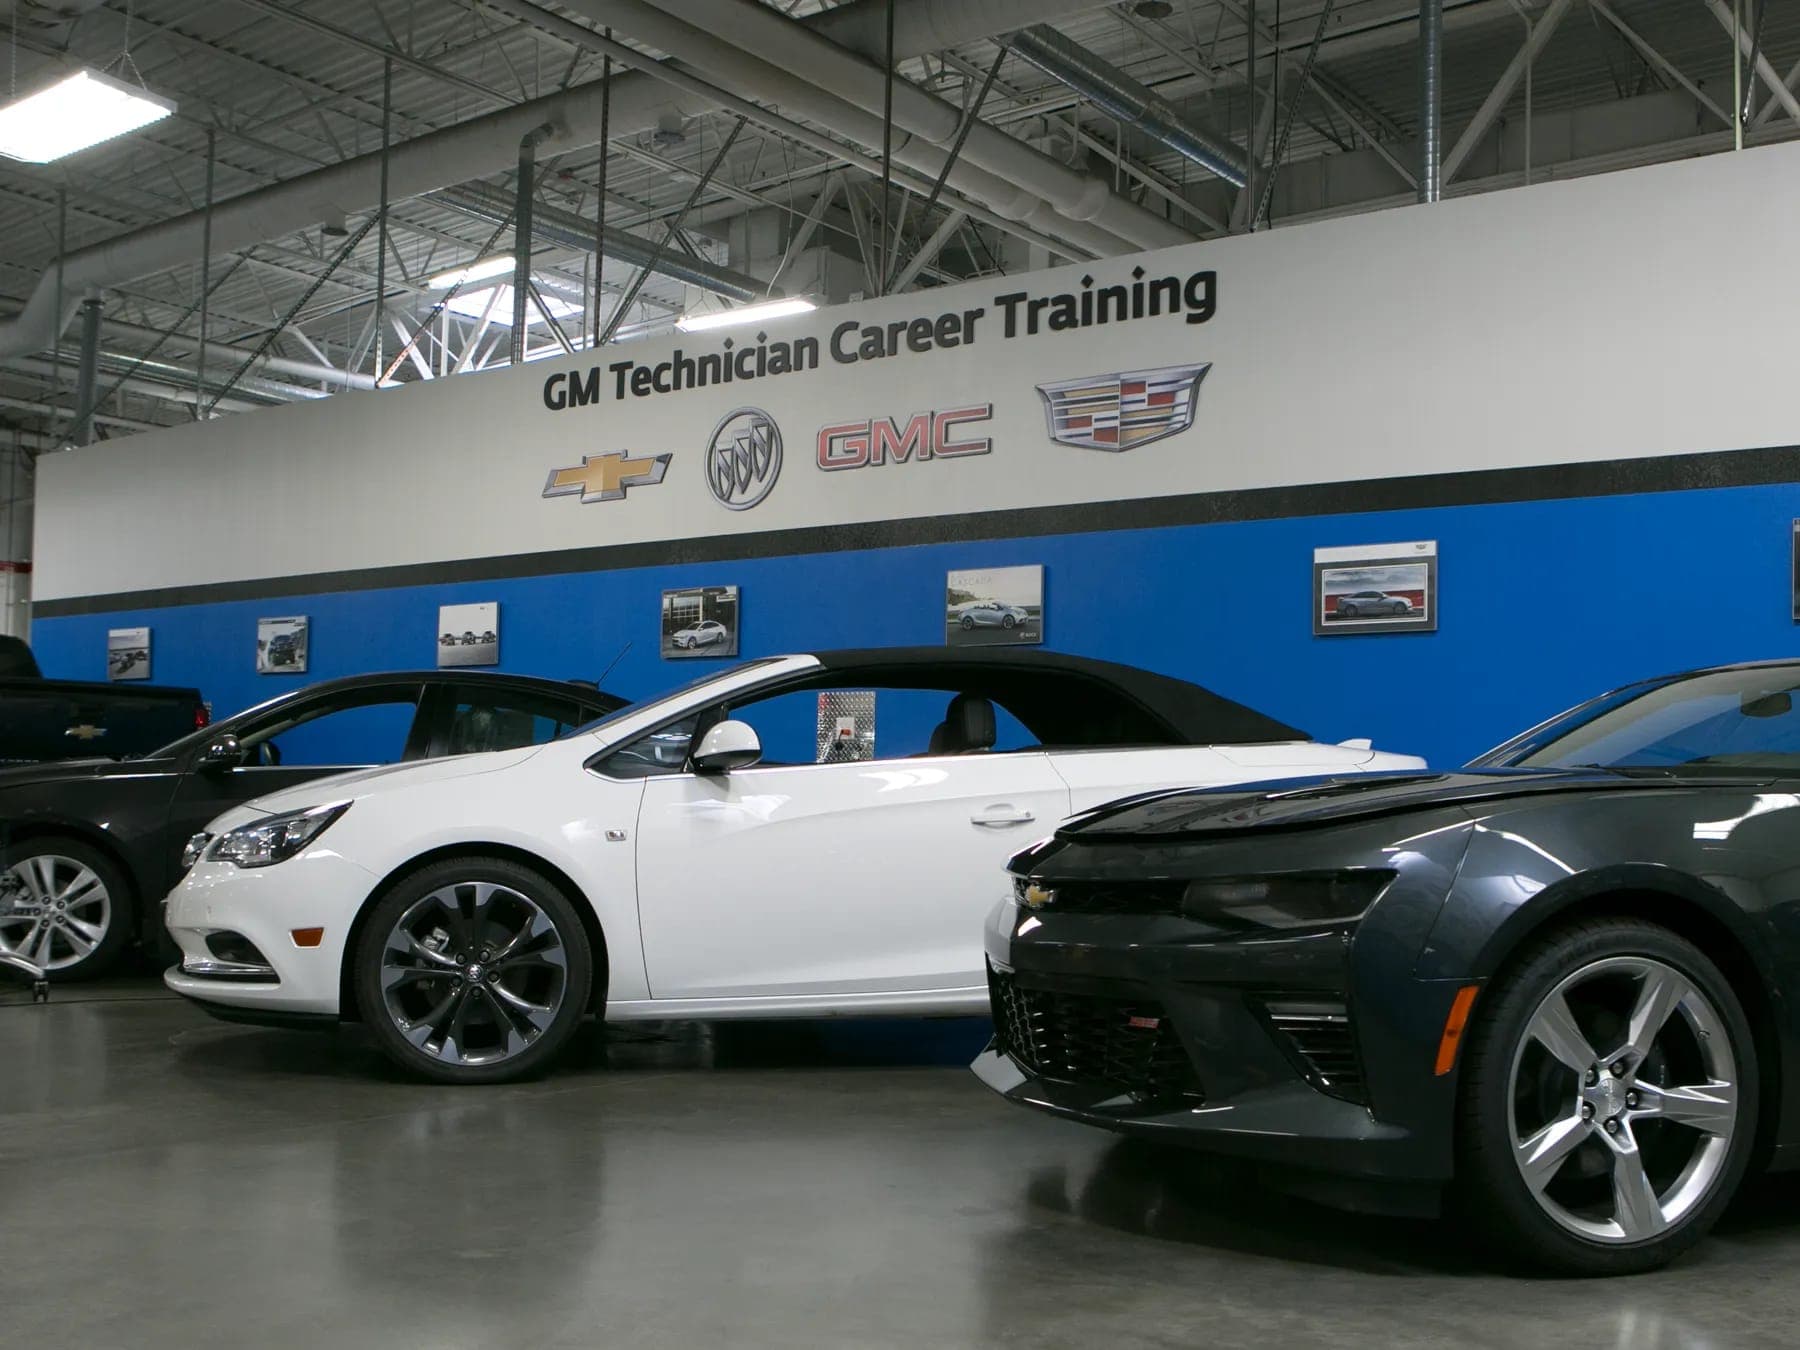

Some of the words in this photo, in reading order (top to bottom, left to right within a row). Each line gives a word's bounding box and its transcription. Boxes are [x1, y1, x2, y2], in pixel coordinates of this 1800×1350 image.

[543, 366, 600, 411] GM
[609, 331, 819, 400] Technician
[830, 307, 984, 364] Career
[994, 265, 1218, 338] Training
[816, 402, 992, 472] GMC
